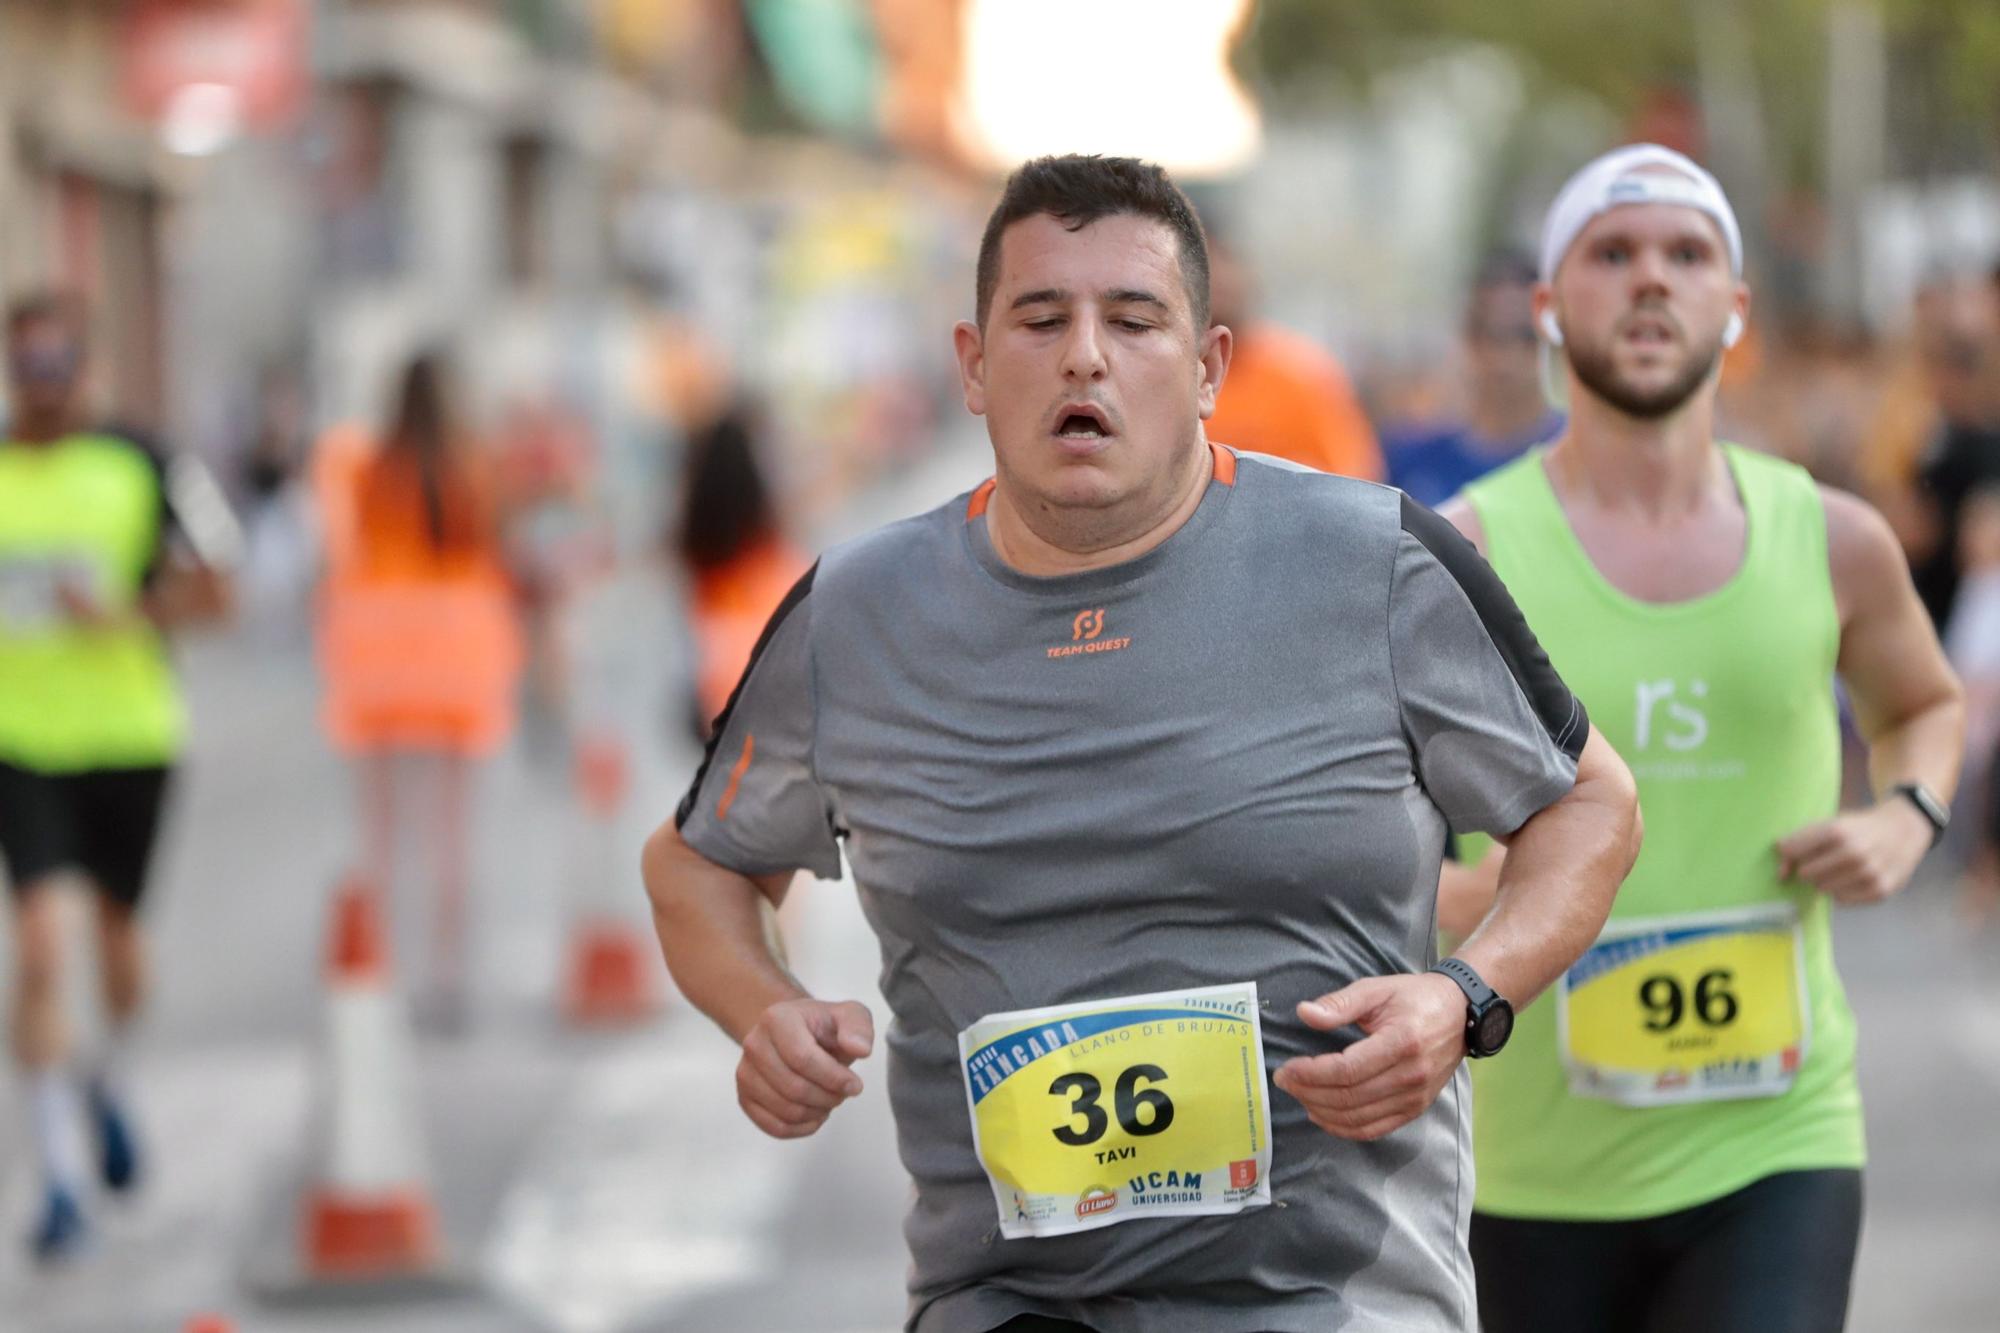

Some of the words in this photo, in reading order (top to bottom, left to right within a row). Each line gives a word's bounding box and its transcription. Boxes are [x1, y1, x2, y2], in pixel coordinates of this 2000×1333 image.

[1046, 645, 1083, 657] TEAM
[1085, 637, 1130, 653] QUEST
[1640, 968, 1739, 1033] 96
[1069, 1029, 1130, 1058] LLANO
[1142, 1024, 1165, 1037] DE
[1177, 1021, 1248, 1036] BRUJAS
[973, 1021, 1080, 1095] ZANCADA
[1048, 1063, 1175, 1147] 36
[1095, 1147, 1137, 1165] TAVI
[1128, 1170, 1202, 1194] UCAM
[1131, 1192, 1202, 1206] UNIVERSIDAD
